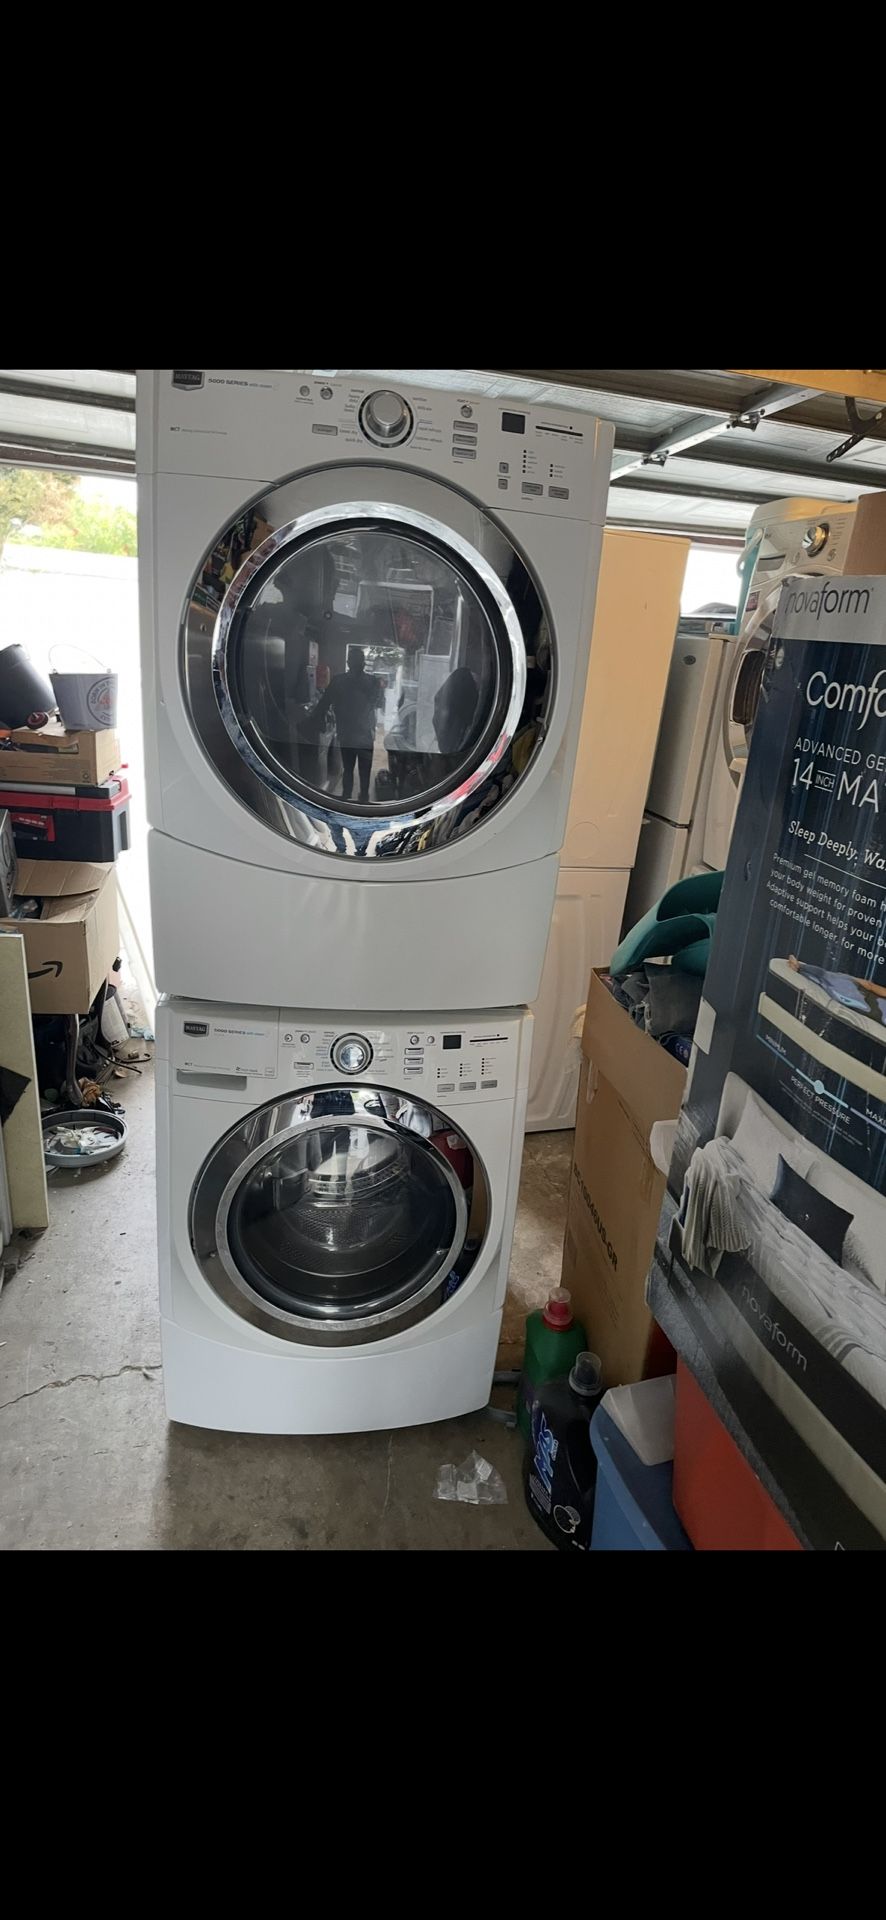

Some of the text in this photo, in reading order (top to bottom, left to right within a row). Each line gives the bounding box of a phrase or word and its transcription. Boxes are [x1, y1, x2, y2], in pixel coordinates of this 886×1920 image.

[785, 581, 870, 621] novaform
[794, 737, 886, 773] ADVANCED GE
[792, 758, 886, 813] 14 INCH MA
[788, 820, 816, 845] Sleep
[863, 849, 886, 871] Wa
[770, 869, 882, 929] your body weight for proven
[773, 852, 802, 874] Premium
[803, 868, 816, 880] gel
[817, 875, 850, 897] memory
[852, 889, 877, 908] foam
[766, 880, 795, 902] Adaptive
[796, 896, 826, 919] support
[826, 911, 848, 931] helps
[850, 925, 875, 943] your
[769, 899, 811, 927] comfortable
[840, 937, 855, 951] for
[857, 947, 885, 965] more
[790, 1075, 851, 1125] PERFECT PRESSURE
[742, 1286, 808, 1373] novaform
